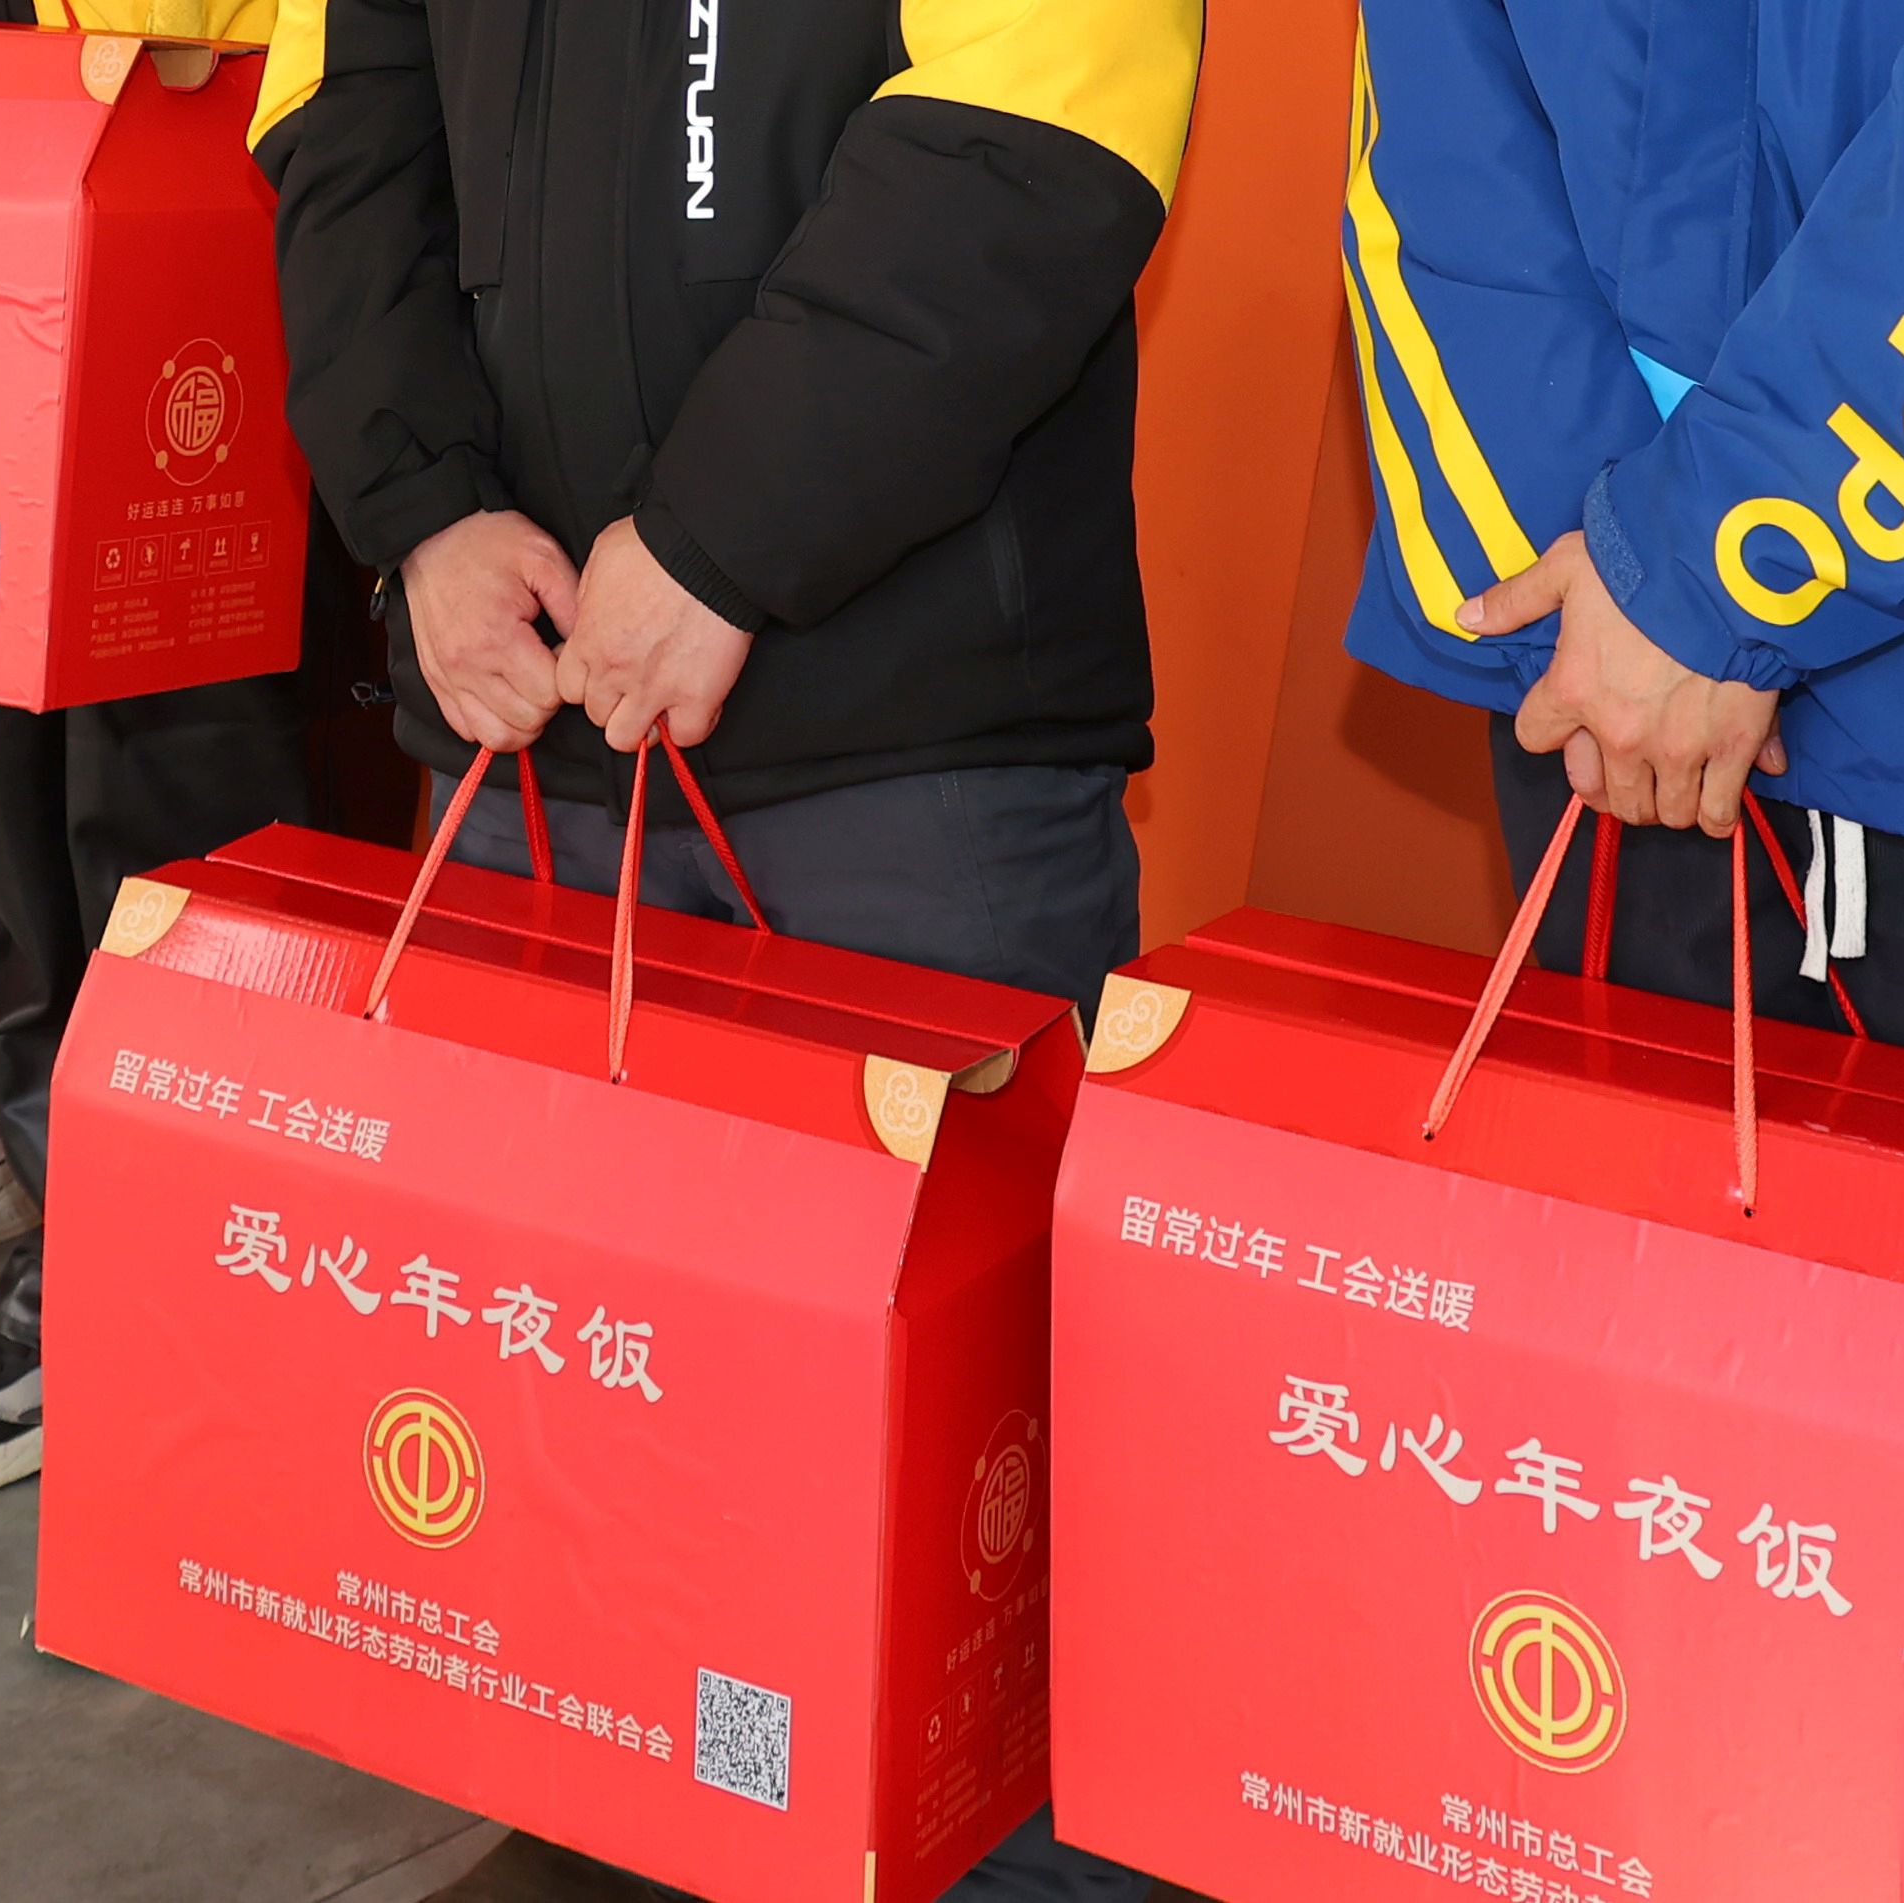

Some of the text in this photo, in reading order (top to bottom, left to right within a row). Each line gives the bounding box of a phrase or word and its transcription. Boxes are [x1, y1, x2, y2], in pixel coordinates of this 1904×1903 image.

[108, 1049, 392, 1163] 留常过年 工会送暖
[214, 1203, 665, 1404] 爱心年夜饭
[1120, 1194, 1477, 1334] 留常过年 工会送暖
[1268, 1373, 1855, 1618] 爱心年夜饭
[177, 1557, 675, 1764] 常州市新就业形态劳动者行业工会联合会
[335, 1571, 502, 1656] 常州市总工会
[1239, 1770, 1606, 1903] 常州市新就业形态劳动
[1440, 1792, 1654, 1899] 常州市总工会
